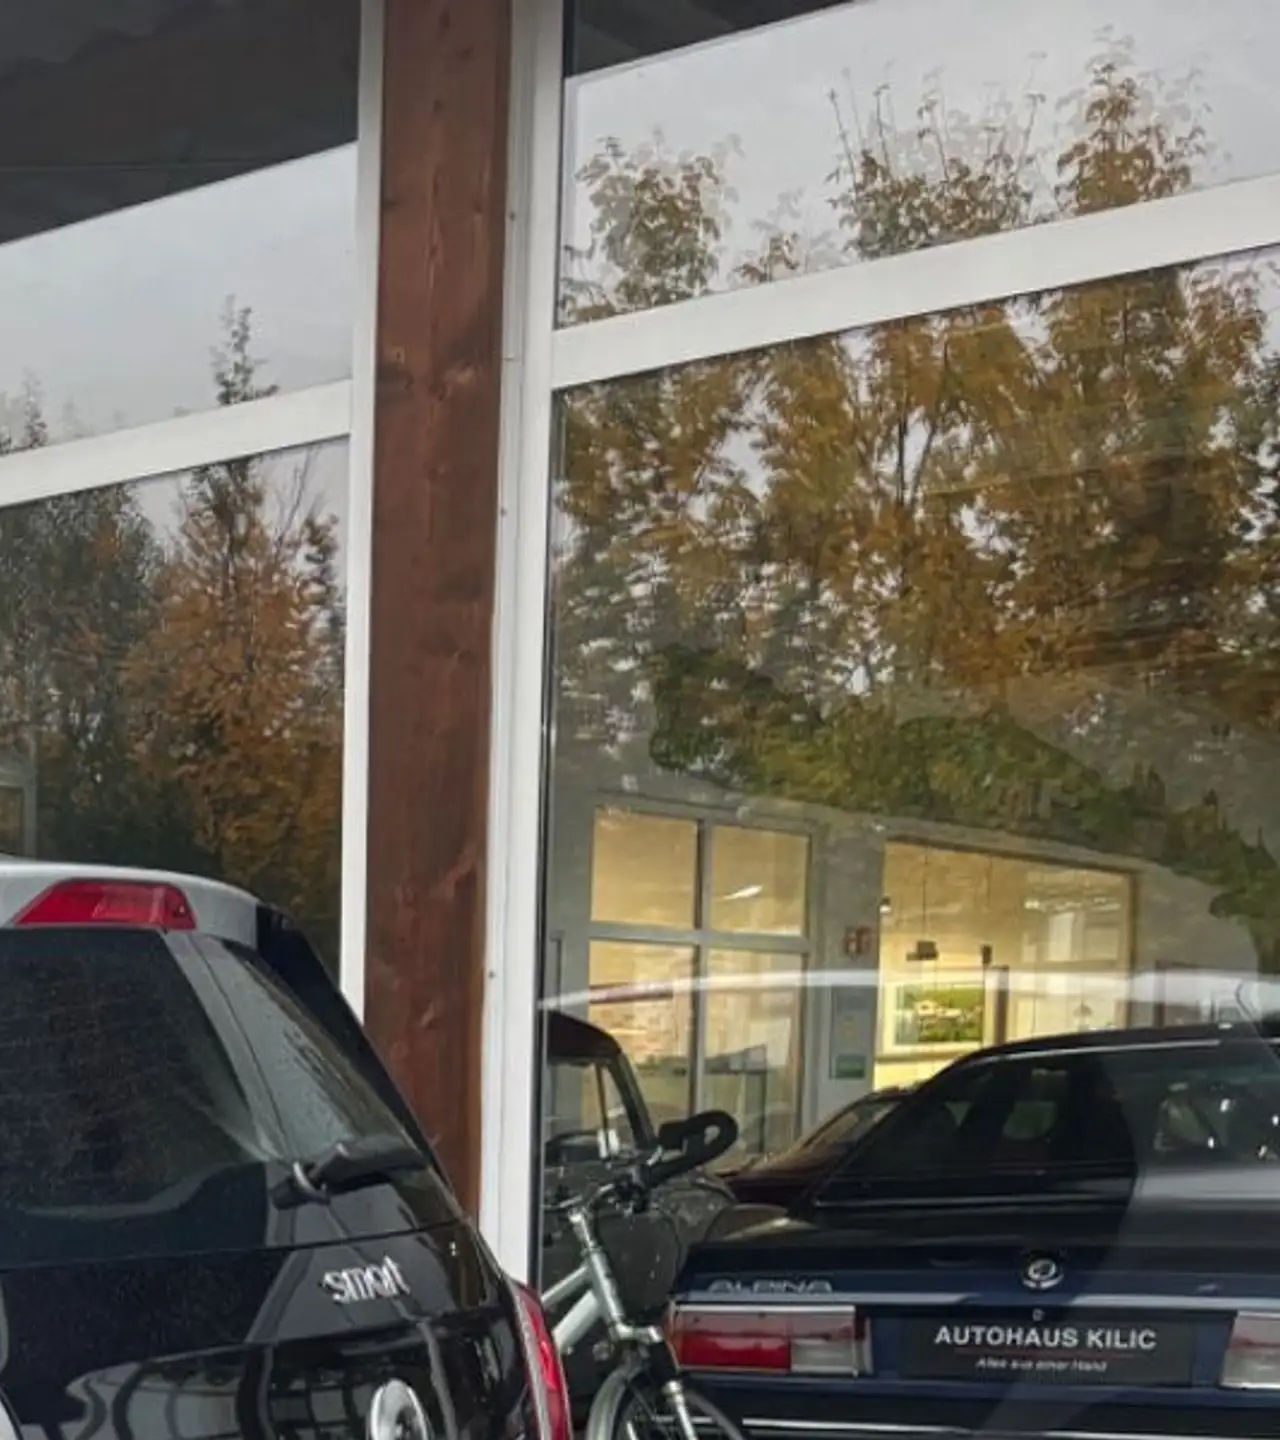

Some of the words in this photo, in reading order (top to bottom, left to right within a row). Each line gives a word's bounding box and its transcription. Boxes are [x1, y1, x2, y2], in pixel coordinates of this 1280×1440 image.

[323, 1255, 411, 1304] smart
[934, 1324, 1080, 1348] AUTOHAUS
[1086, 1326, 1158, 1350] KILIC
